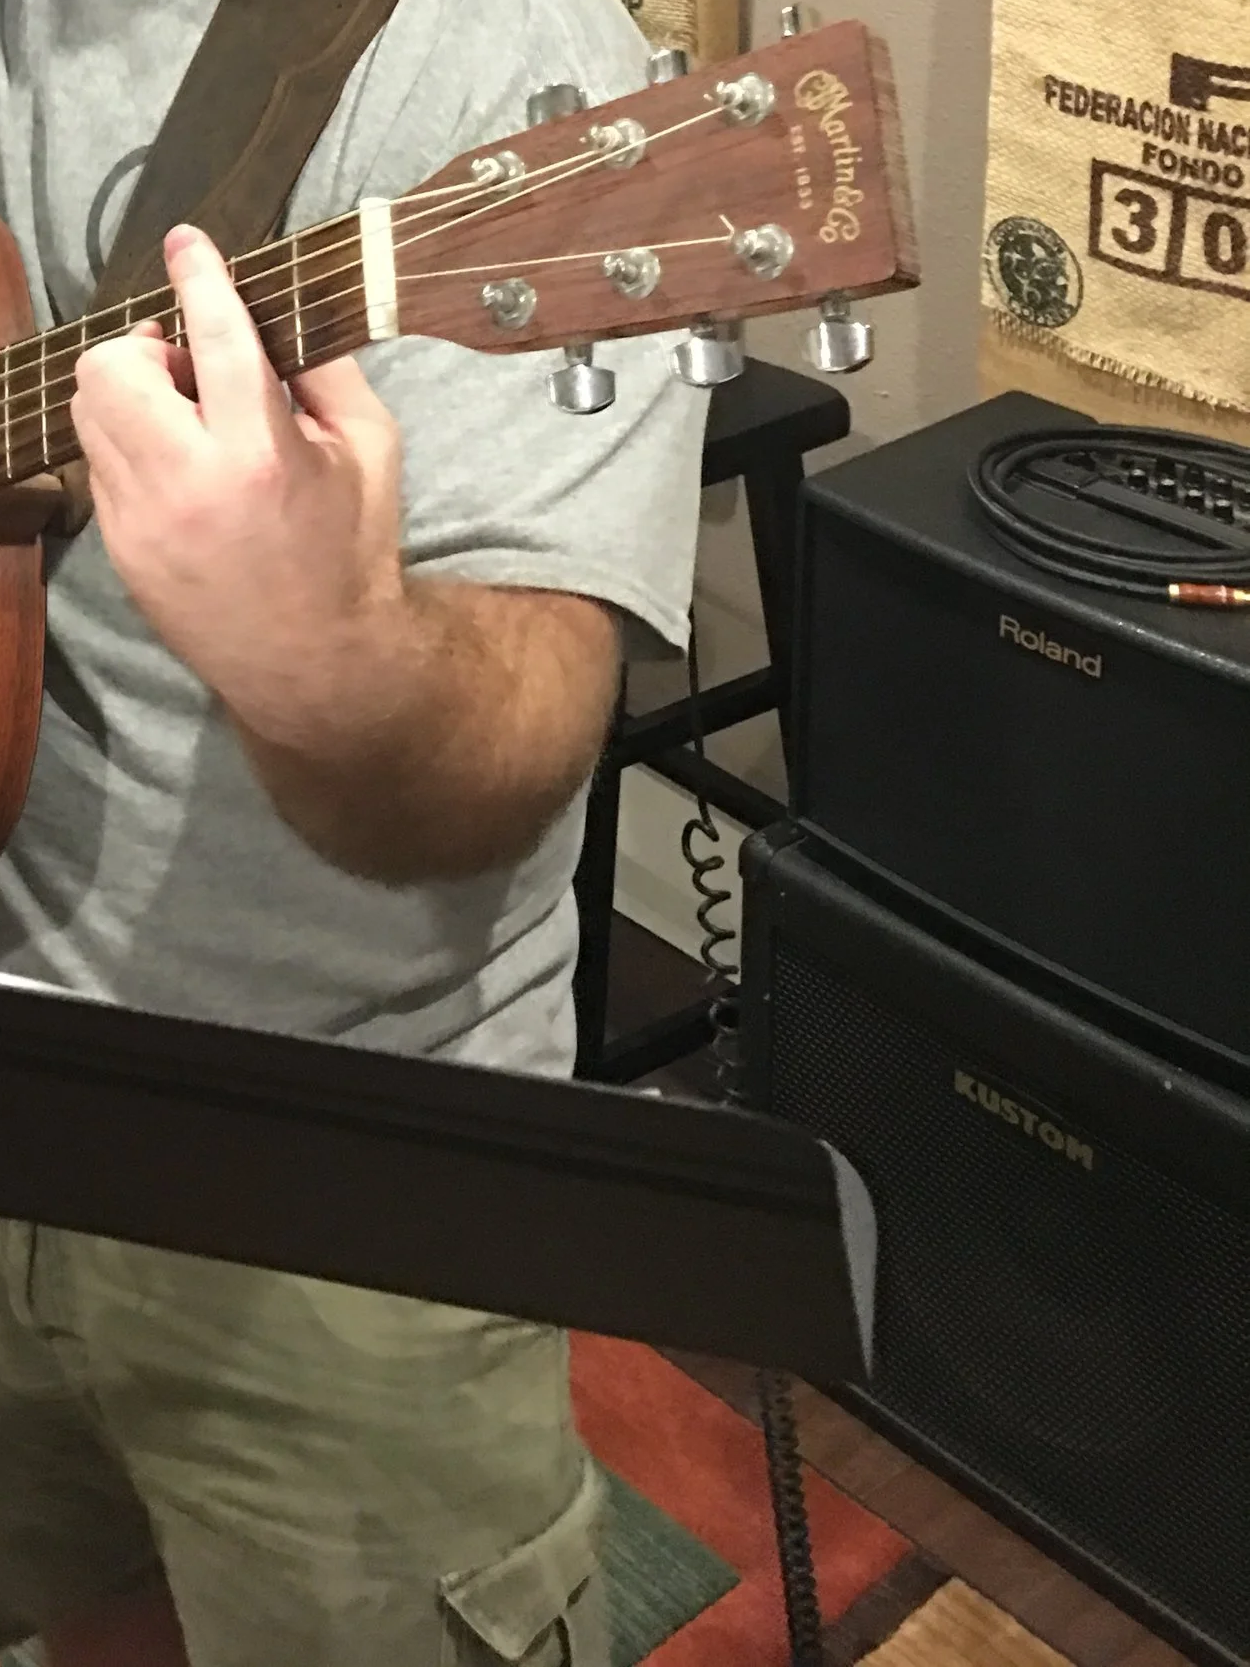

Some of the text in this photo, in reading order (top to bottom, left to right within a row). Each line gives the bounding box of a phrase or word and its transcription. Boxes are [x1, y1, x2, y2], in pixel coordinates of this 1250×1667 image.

[1045, 74, 1190, 146] FEDERACION
[1142, 142, 1244, 189] FONDO
[1111, 188, 1158, 254] 3
[1000, 614, 1102, 679] Roland
[954, 1069, 1094, 1171] KUSTOM
